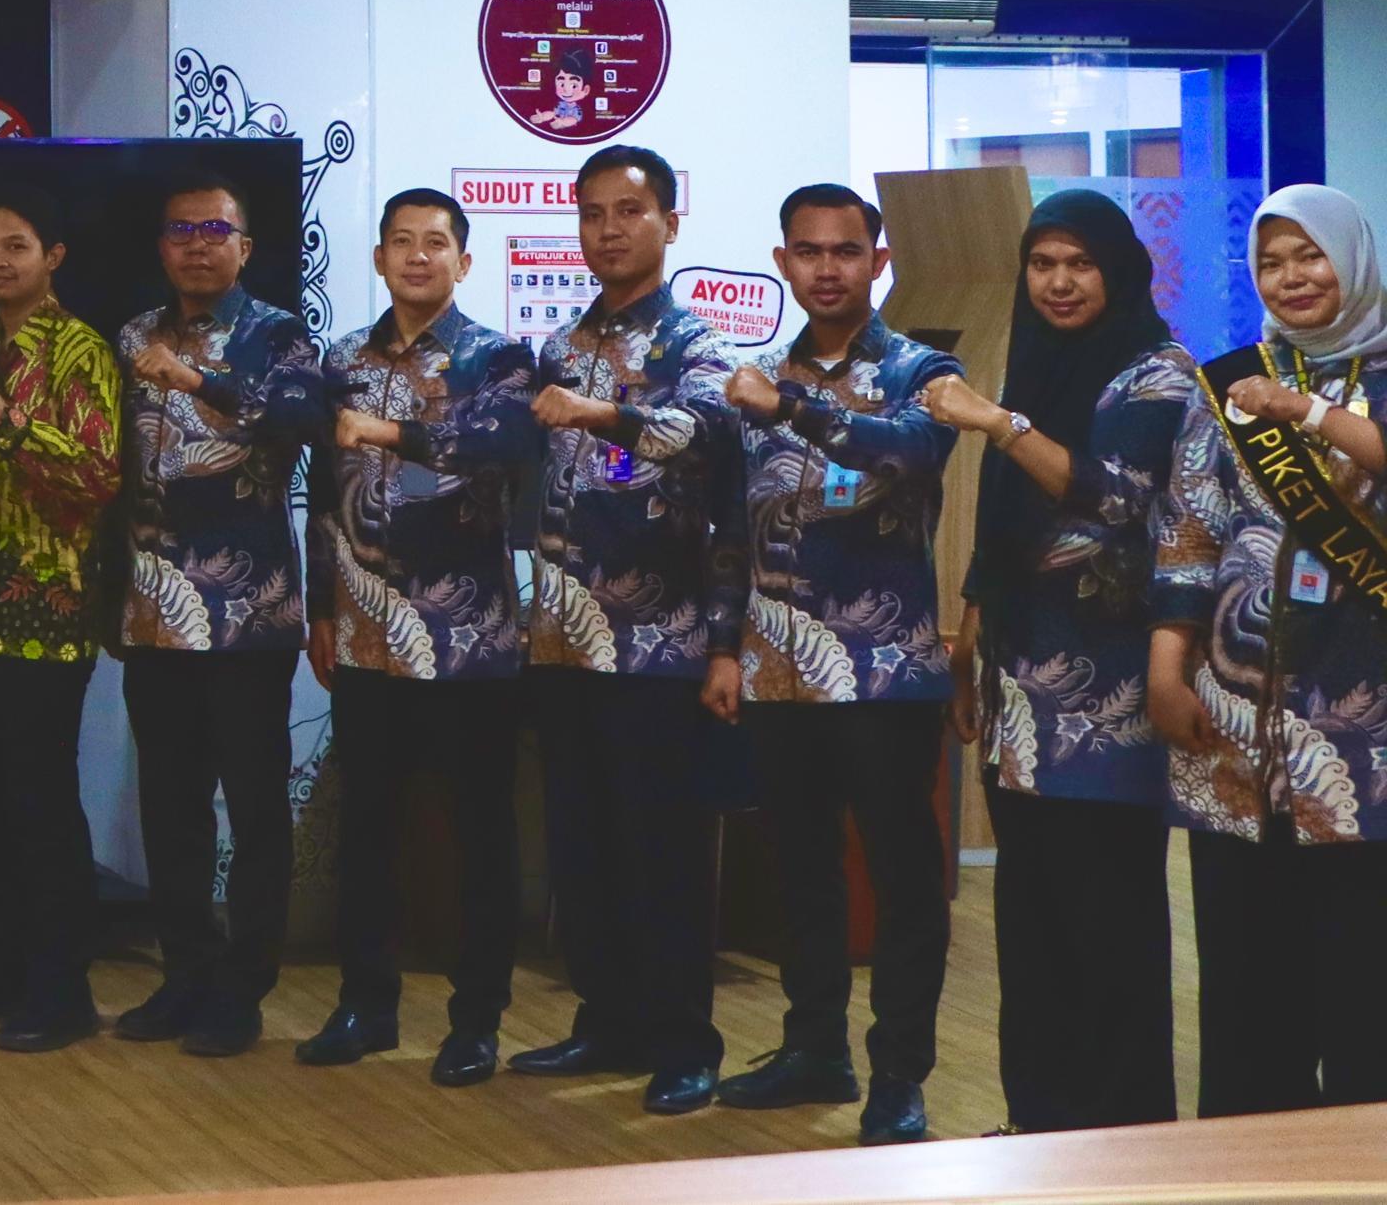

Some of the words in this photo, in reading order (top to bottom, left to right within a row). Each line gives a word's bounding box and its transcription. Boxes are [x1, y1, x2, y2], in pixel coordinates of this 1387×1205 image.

[557, 1, 593, 11] melalui
[462, 181, 534, 204] SUDUT
[519, 252, 565, 261] PETUNJUK
[691, 279, 764, 308] AYO!!!
[688, 306, 731, 322] FAATKAN
[733, 312, 775, 327] FASILITAS
[733, 325, 764, 337] GRATIS
[1246, 426, 1330, 523] PIKET
[1320, 526, 1387, 608] LAYA
